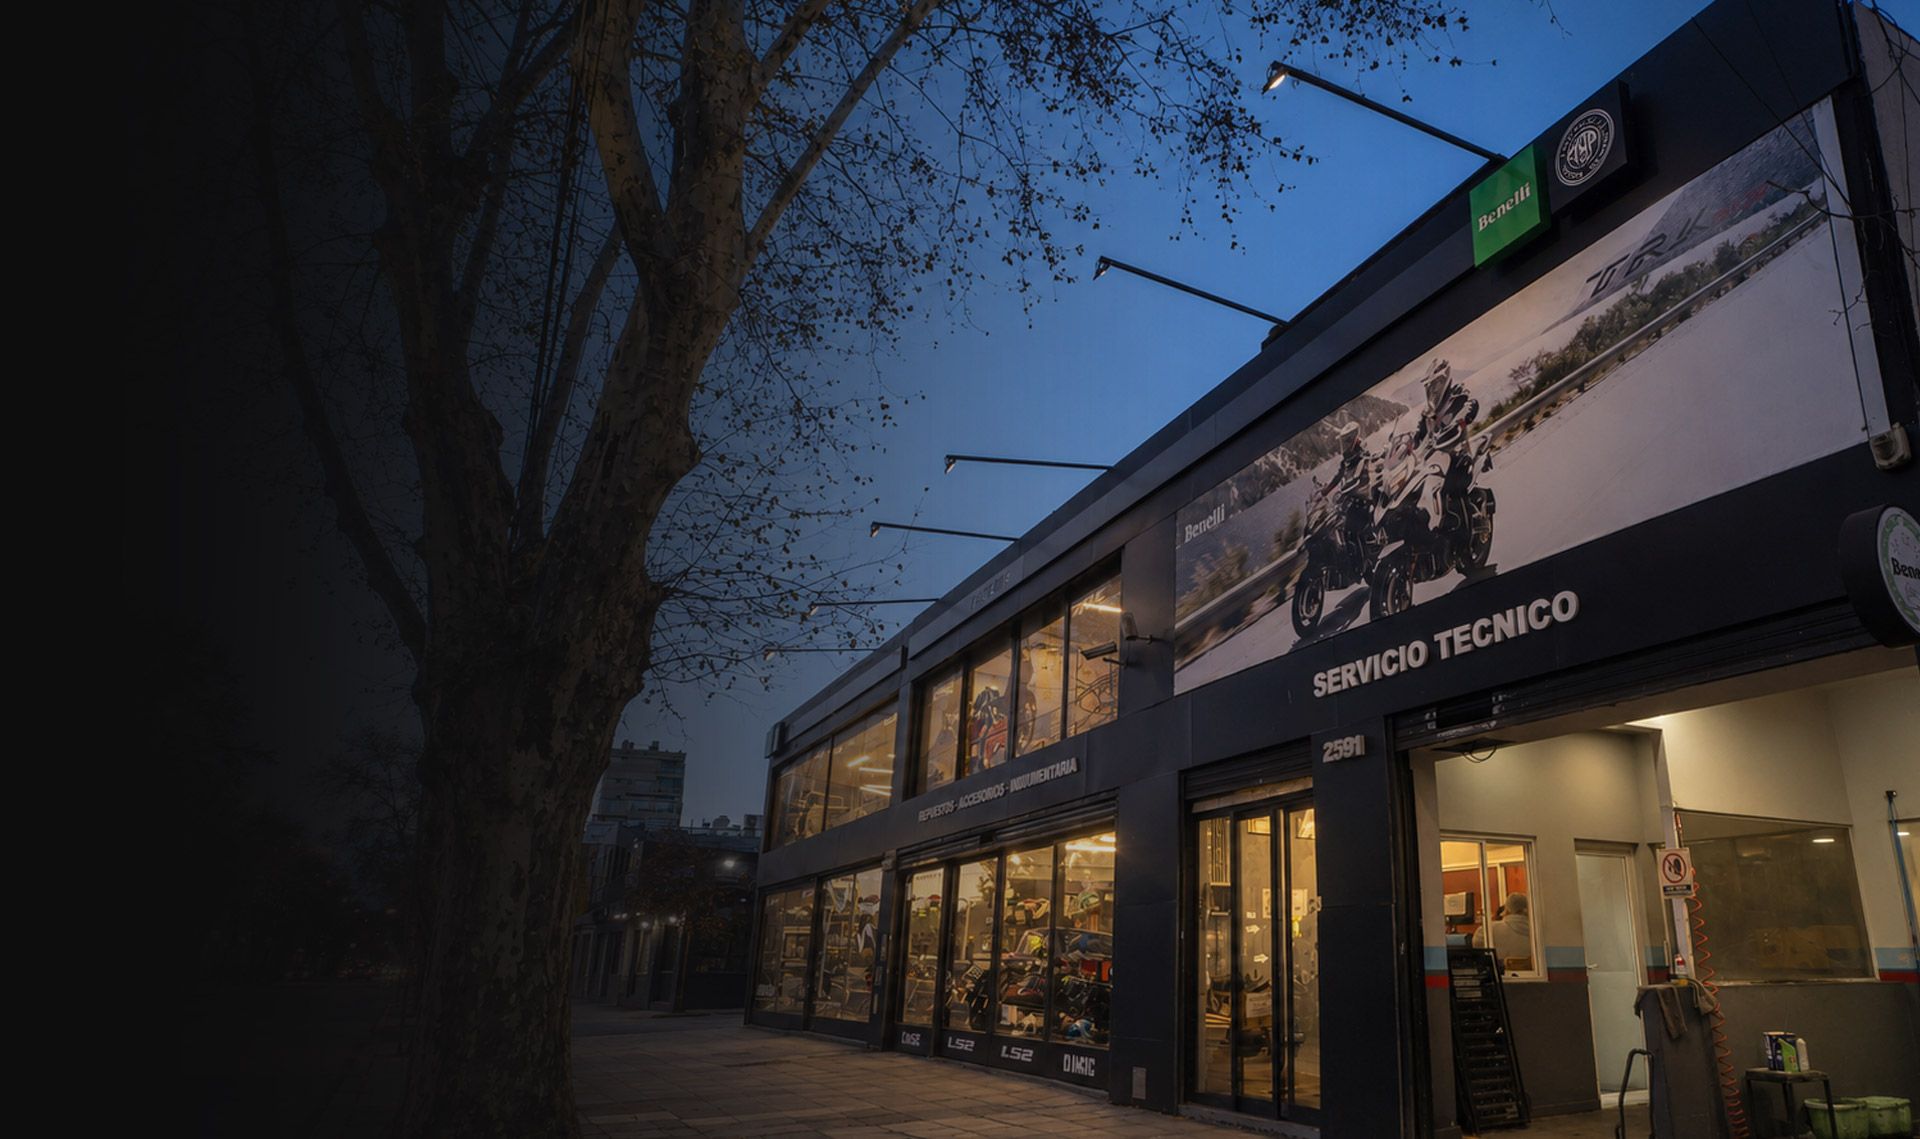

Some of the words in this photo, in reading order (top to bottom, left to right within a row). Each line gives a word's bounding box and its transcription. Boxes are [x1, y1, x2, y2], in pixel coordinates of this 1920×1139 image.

[1478, 182, 1531, 232] Benelli
[1184, 503, 1226, 543] Benelli
[1313, 639, 1429, 698] SERVICIO
[1434, 590, 1580, 660] TECNICO
[1323, 734, 1365, 763] 2591
[958, 783, 1005, 809] ACCESORIOS
[947, 1036, 975, 1052] LS2
[1001, 1045, 1034, 1063] LS2
